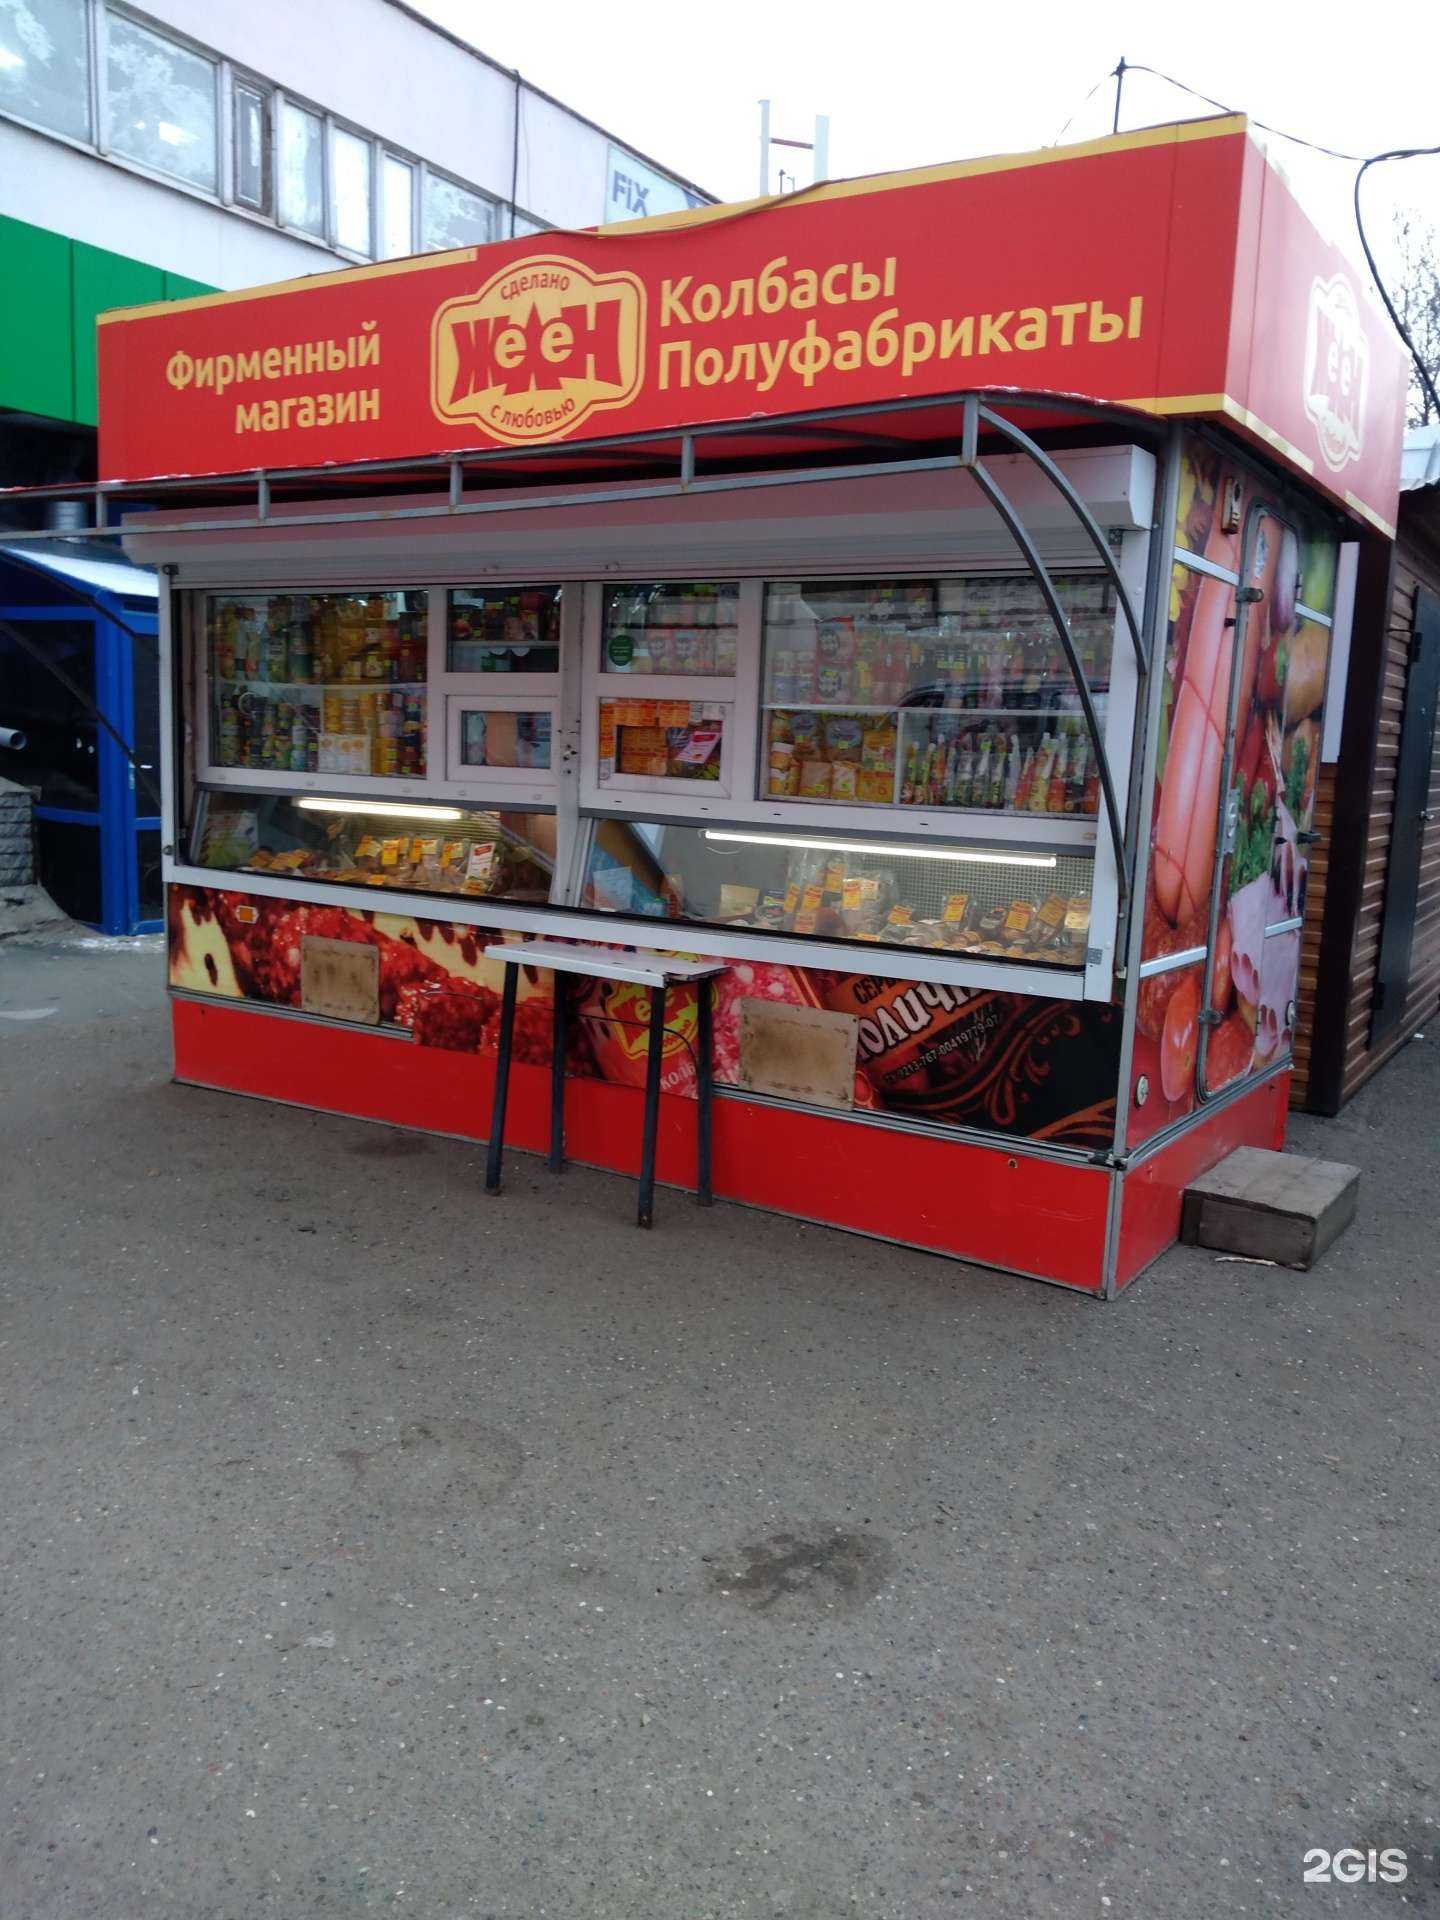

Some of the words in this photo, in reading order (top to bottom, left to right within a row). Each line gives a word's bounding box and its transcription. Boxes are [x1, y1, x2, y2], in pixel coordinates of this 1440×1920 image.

[500, 272, 570, 301] сделано
[660, 256, 897, 327] Колбасы
[166, 320, 380, 395] Фирменный
[658, 296, 1144, 392] Полуфабрикаты
[235, 389, 380, 434] магазин
[501, 397, 576, 428] любовью
